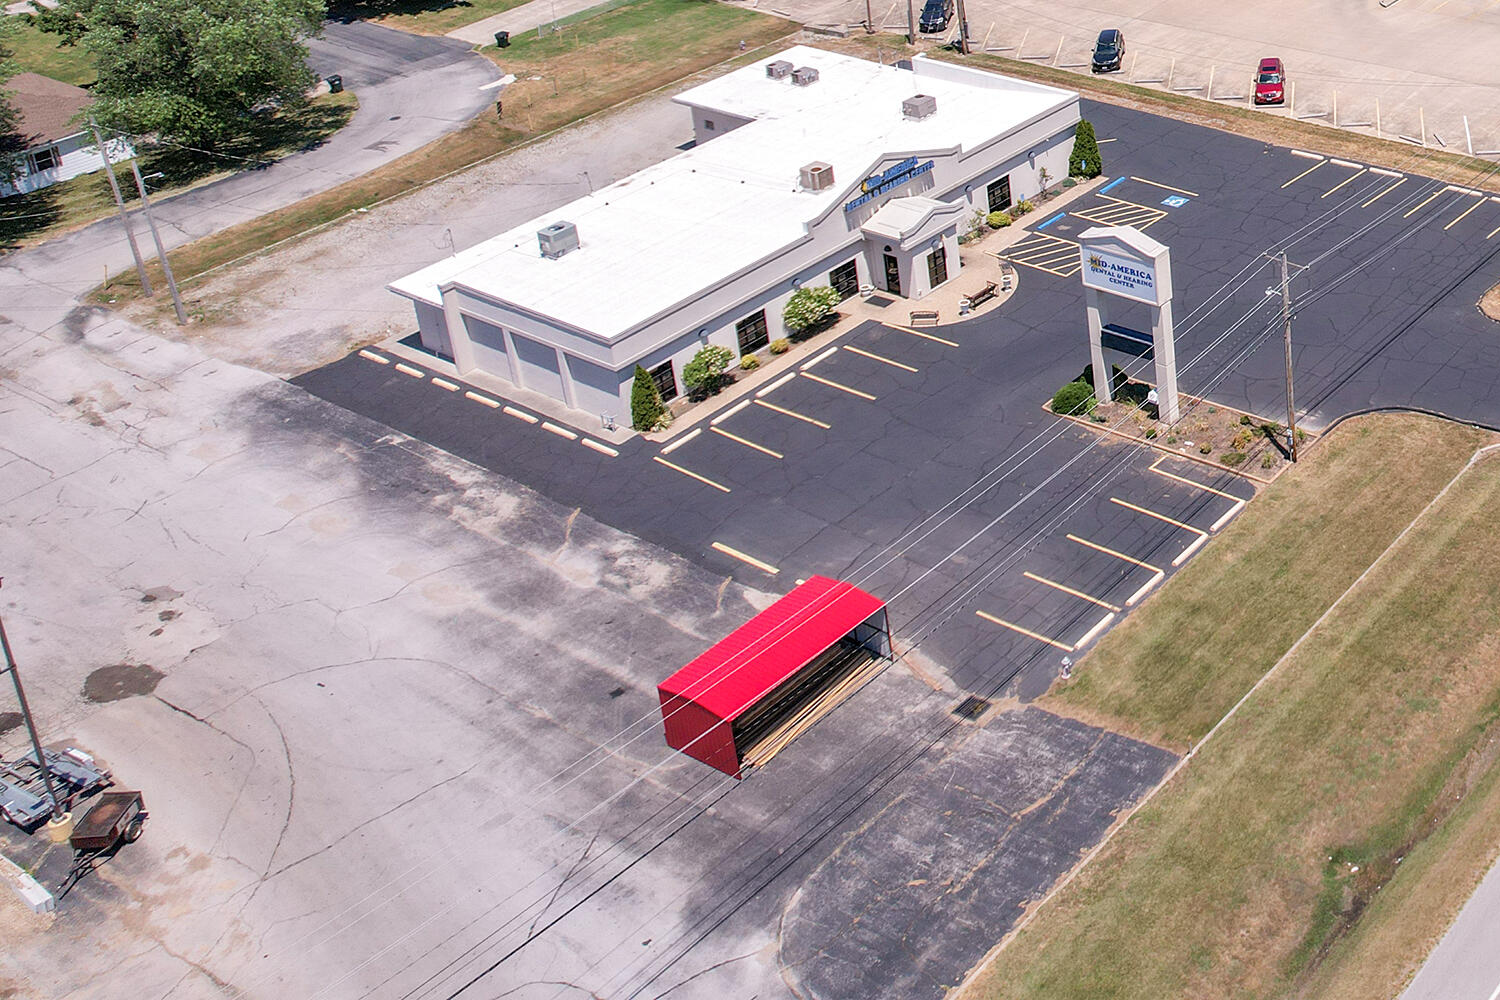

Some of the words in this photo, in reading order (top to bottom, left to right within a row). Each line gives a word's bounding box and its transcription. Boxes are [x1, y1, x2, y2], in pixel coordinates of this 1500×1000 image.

[1090, 258, 1152, 280] MID-AMERICA
[1090, 266, 1116, 277] DENTAL
[1123, 275, 1153, 288] HEARING
[1109, 278, 1135, 289] CENTER
